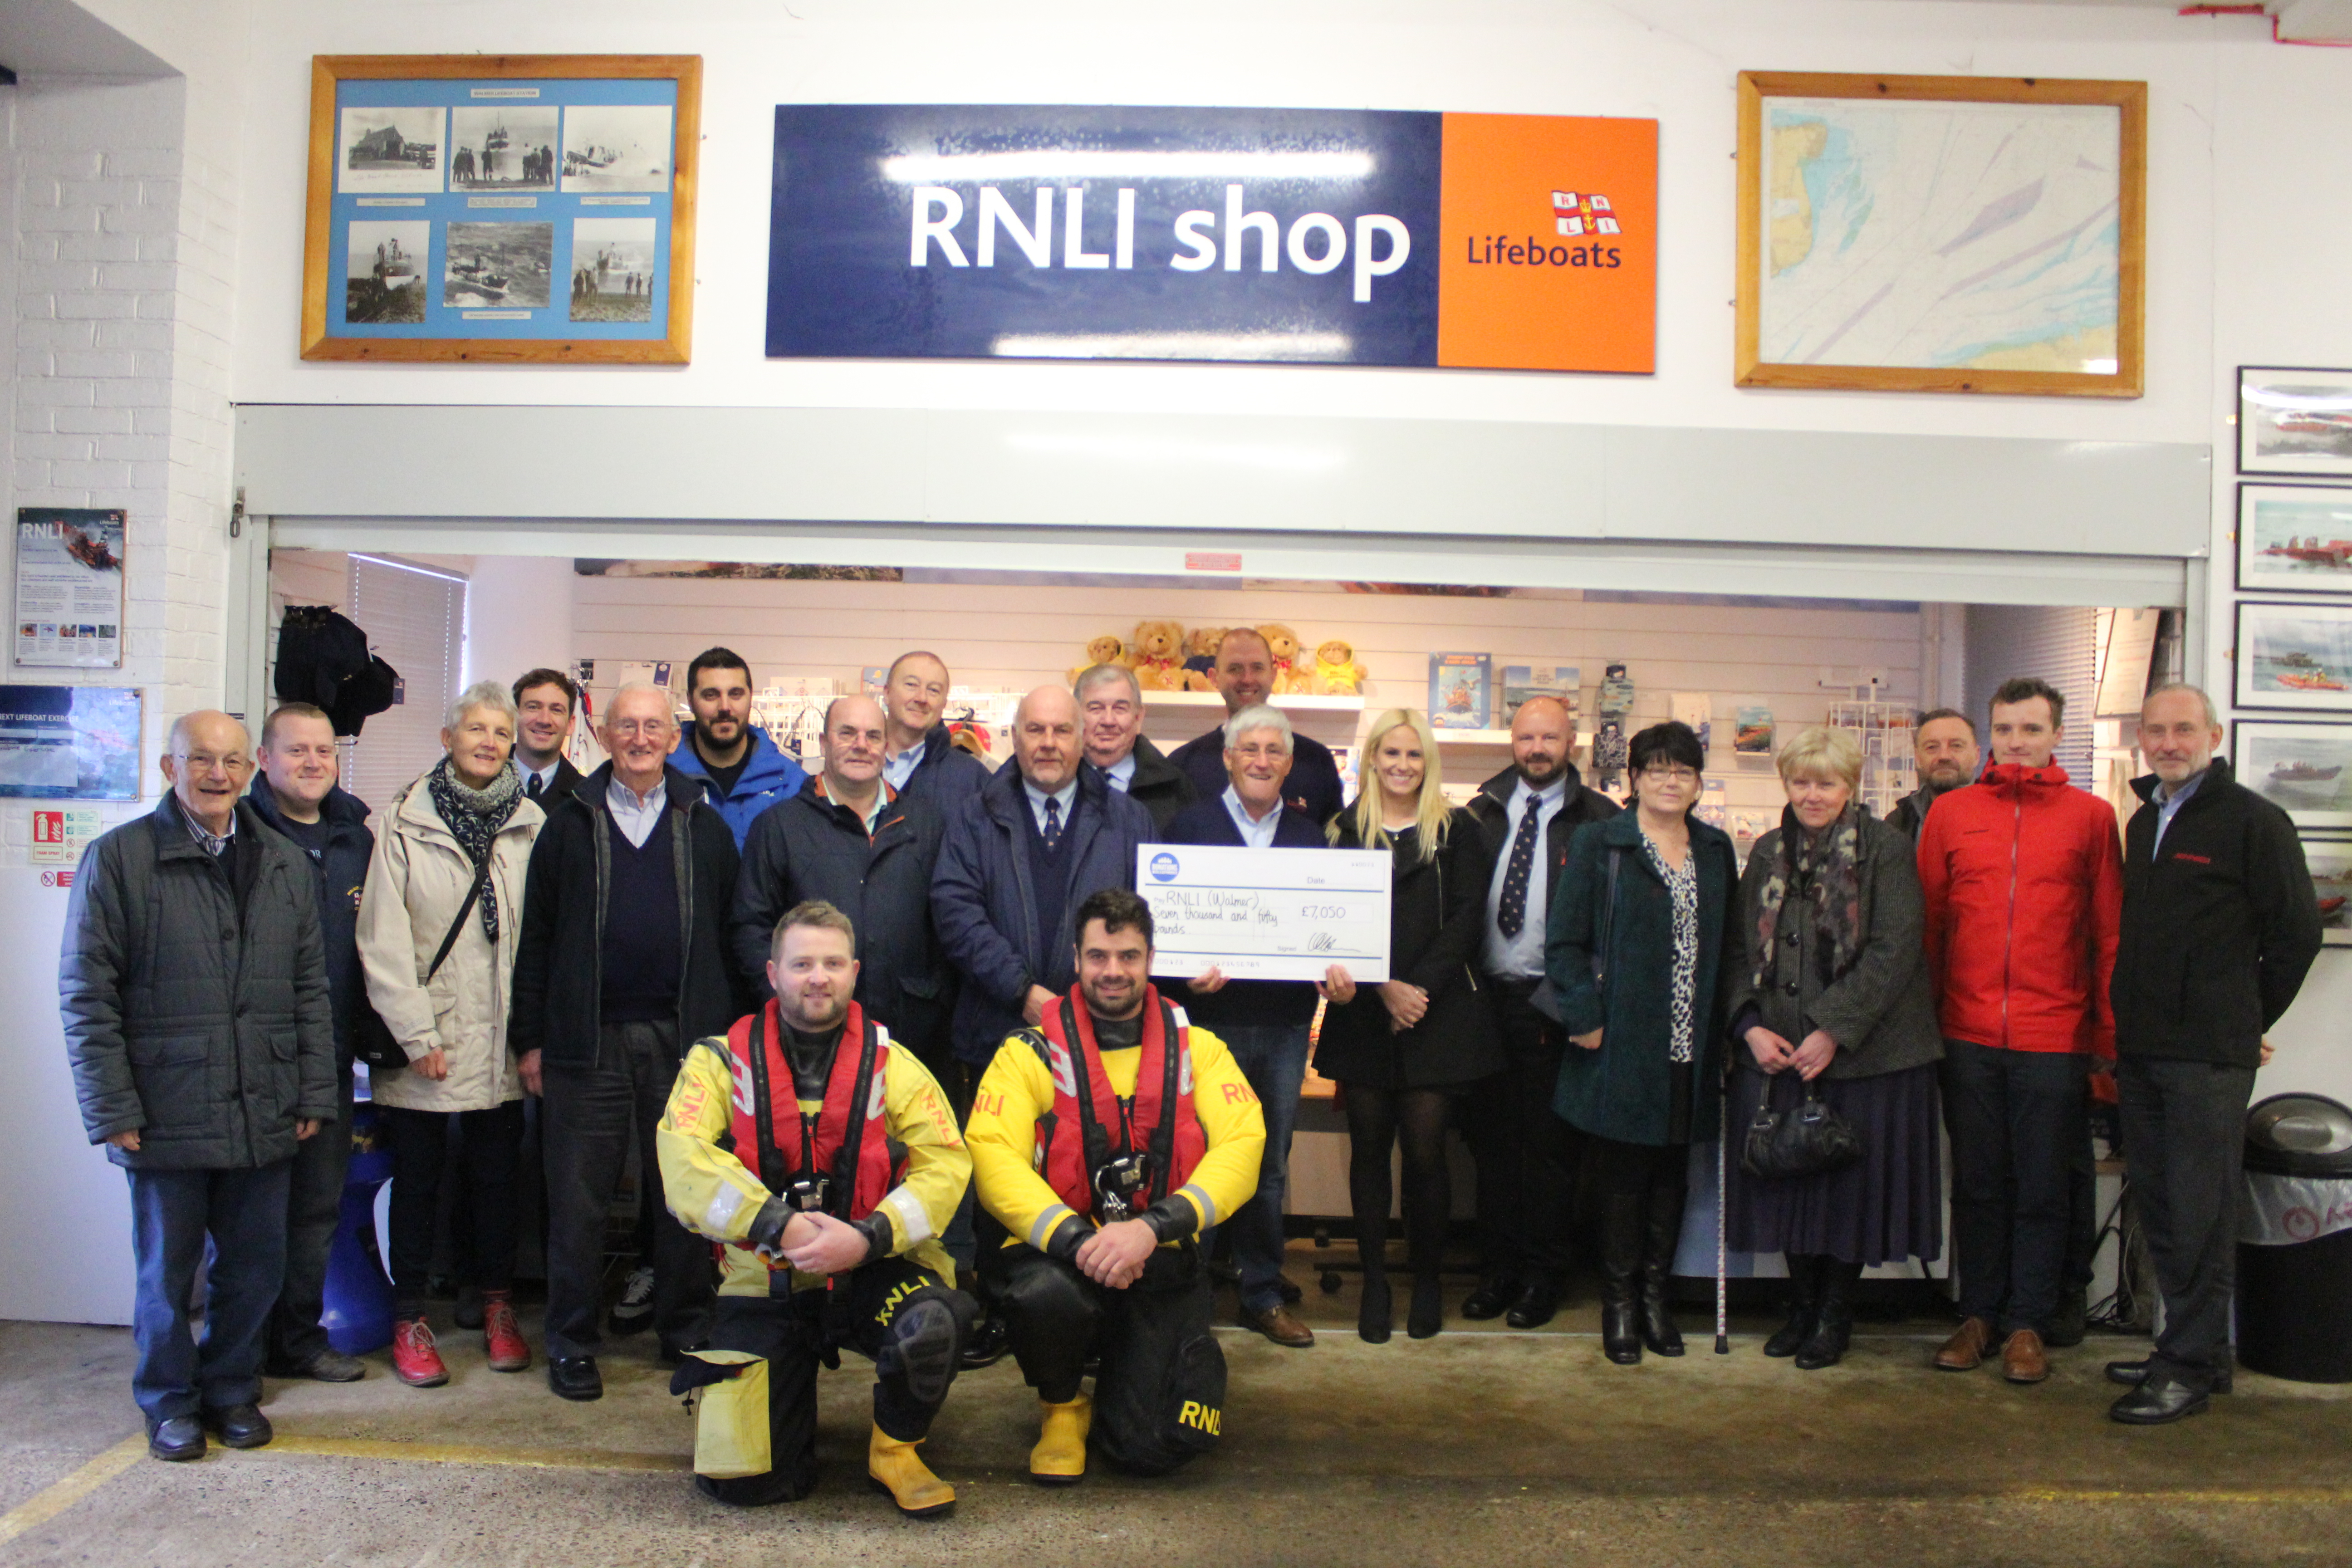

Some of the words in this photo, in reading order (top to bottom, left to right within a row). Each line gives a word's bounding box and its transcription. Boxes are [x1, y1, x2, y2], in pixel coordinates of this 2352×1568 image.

[910, 186, 1135, 270] RNLI
[1170, 184, 1411, 303] shop
[1468, 235, 1621, 268] Lifeboats
[22, 523, 64, 539] RNLI
[1307, 876, 1325, 884] Date
[1166, 891, 1200, 906] RNLI
[1208, 889, 1259, 911] (Walmer)
[1153, 906, 1179, 921] Seven
[1185, 906, 1223, 921] thousand
[1231, 910, 1248, 921] and
[1302, 906, 1346, 920] £7,050
[1221, 1083, 1259, 1105] RN
[676, 1083, 706, 1128] RNLI
[974, 1094, 1004, 1117] NLI
[1178, 1400, 1220, 1436] RNL
